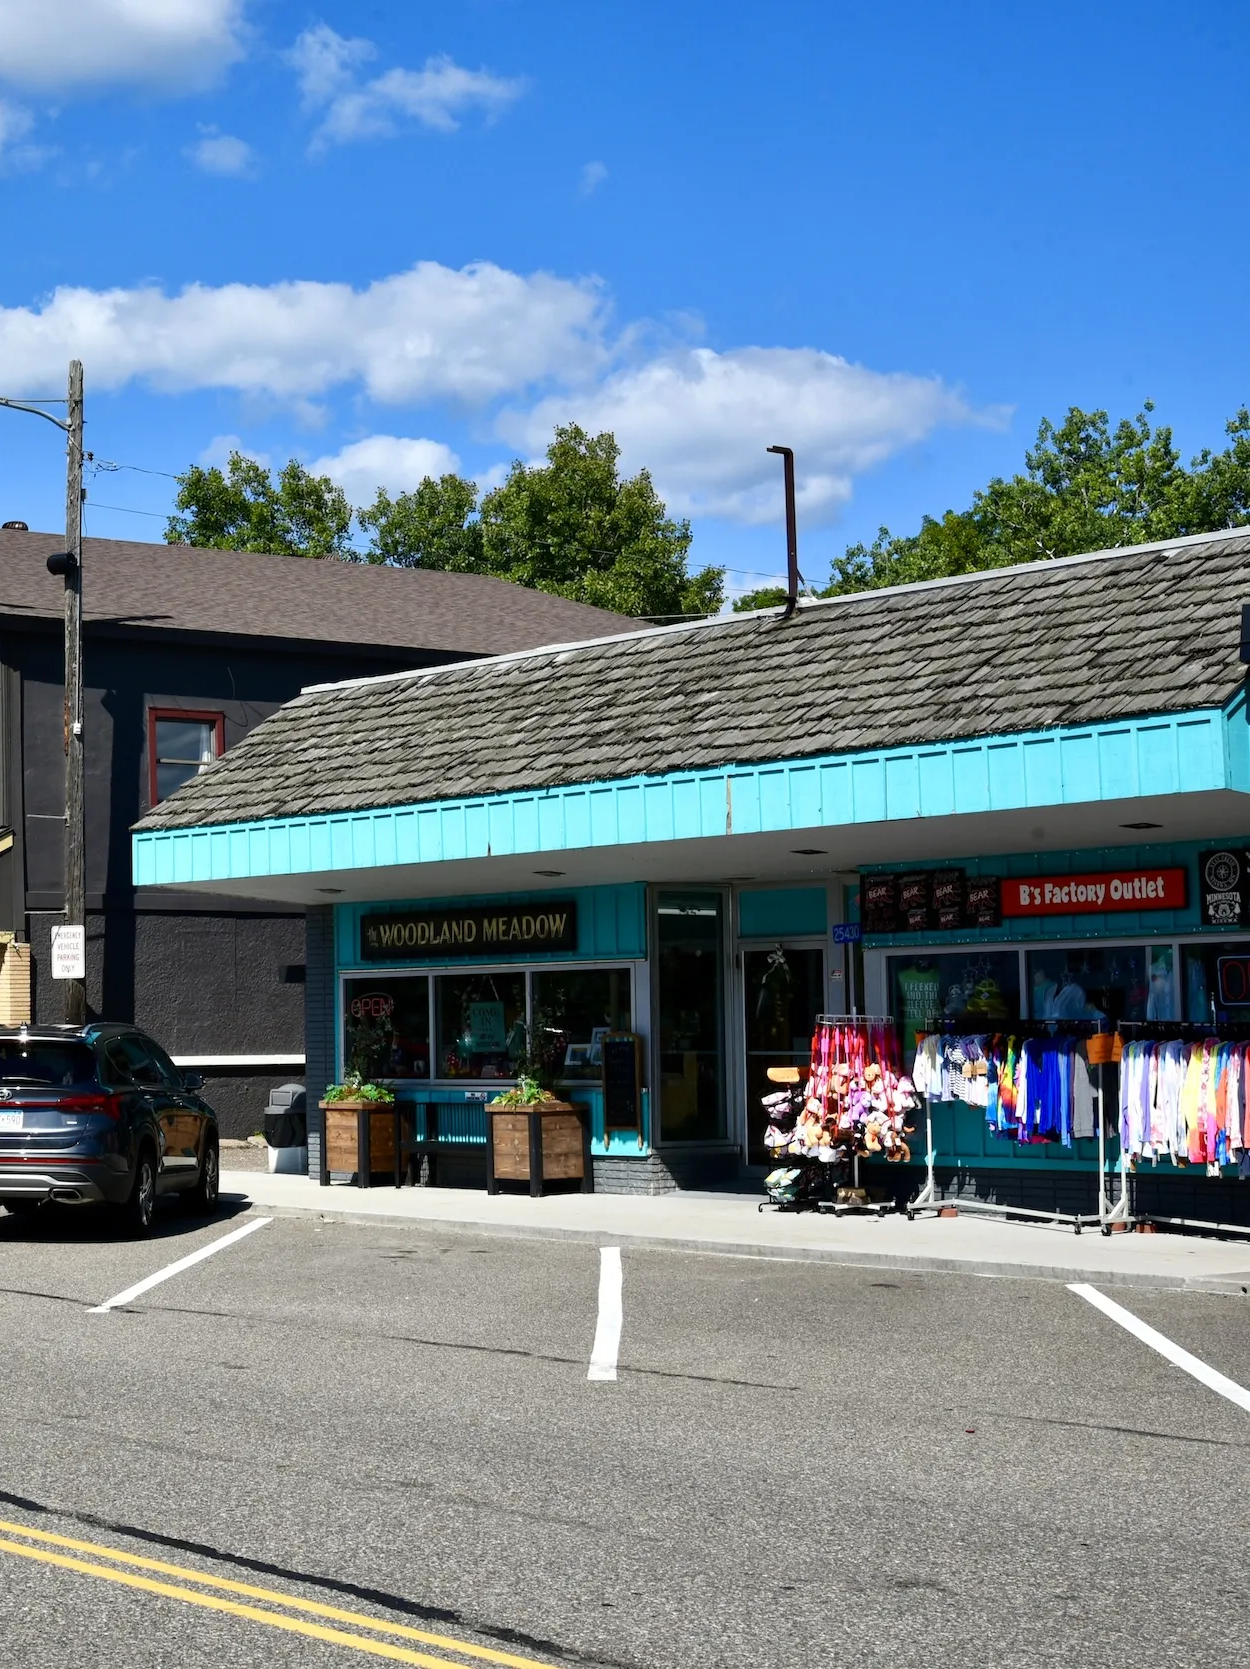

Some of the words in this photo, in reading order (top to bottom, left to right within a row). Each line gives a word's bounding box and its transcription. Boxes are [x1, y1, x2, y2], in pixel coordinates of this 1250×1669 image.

[868, 886, 887, 899] BEAR
[902, 886, 919, 899] BEAR
[935, 884, 953, 898] BEAR
[969, 889, 989, 902] BEAR
[1019, 884, 1042, 906] B's
[1109, 876, 1165, 900] Outlet
[1206, 891, 1241, 905] MINNESOTA
[378, 919, 477, 947] WOODLAND
[482, 913, 567, 942] MEADOW
[833, 925, 860, 942] 25430
[56, 942, 80, 951] VEHICLE
[56, 953, 80, 962] PARKING
[910, 982, 940, 991] FLEXED
[351, 998, 394, 1017] OPEN
[481, 1017, 492, 1026] IN
